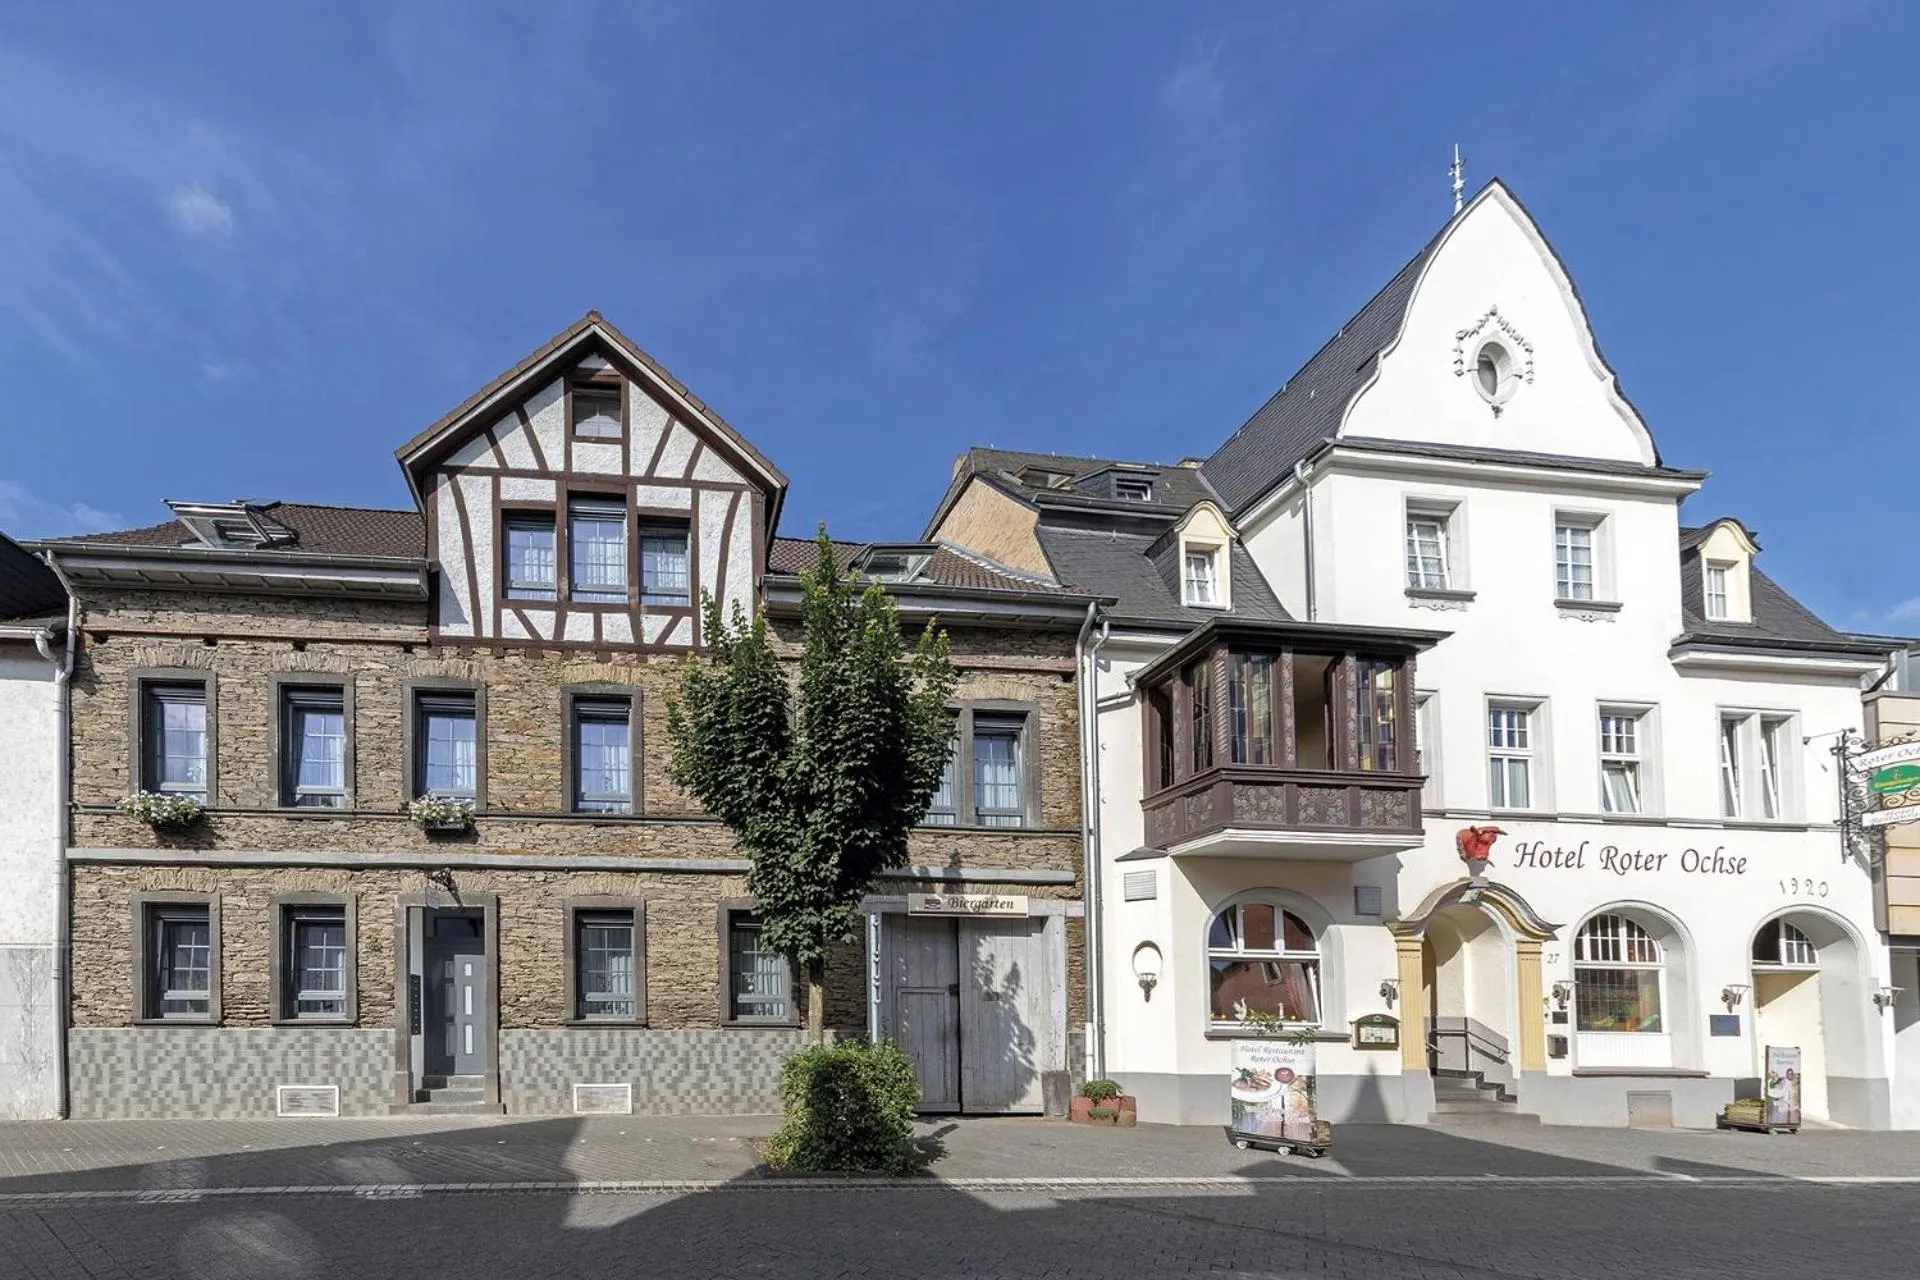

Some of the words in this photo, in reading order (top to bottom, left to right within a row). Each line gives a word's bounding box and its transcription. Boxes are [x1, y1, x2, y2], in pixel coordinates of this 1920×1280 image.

[1513, 840, 1590, 869] Hotel
[1600, 845, 1668, 876] Roter
[1681, 846, 1747, 875] Ochse
[1779, 877, 1829, 898] 1920
[948, 898, 1014, 912] Biergarten
[1547, 953, 1560, 964] 27
